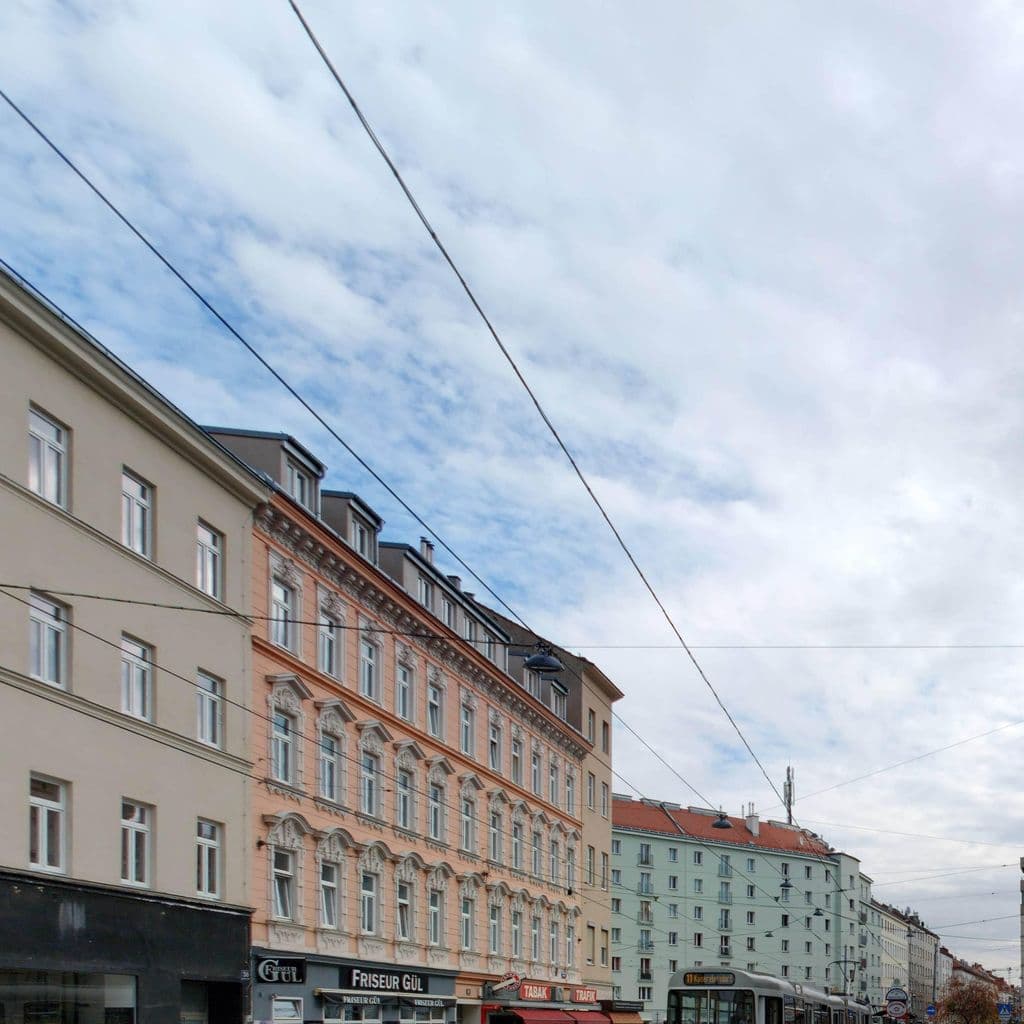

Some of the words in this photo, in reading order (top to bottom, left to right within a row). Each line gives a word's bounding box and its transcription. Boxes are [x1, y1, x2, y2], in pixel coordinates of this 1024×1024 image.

[352, 969, 400, 989] FRISEUR
[403, 974, 423, 991] GÜL
[343, 996, 368, 1004] FRISEUR
[525, 985, 548, 999] TABAK
[576, 989, 595, 1001] TRAFIK
